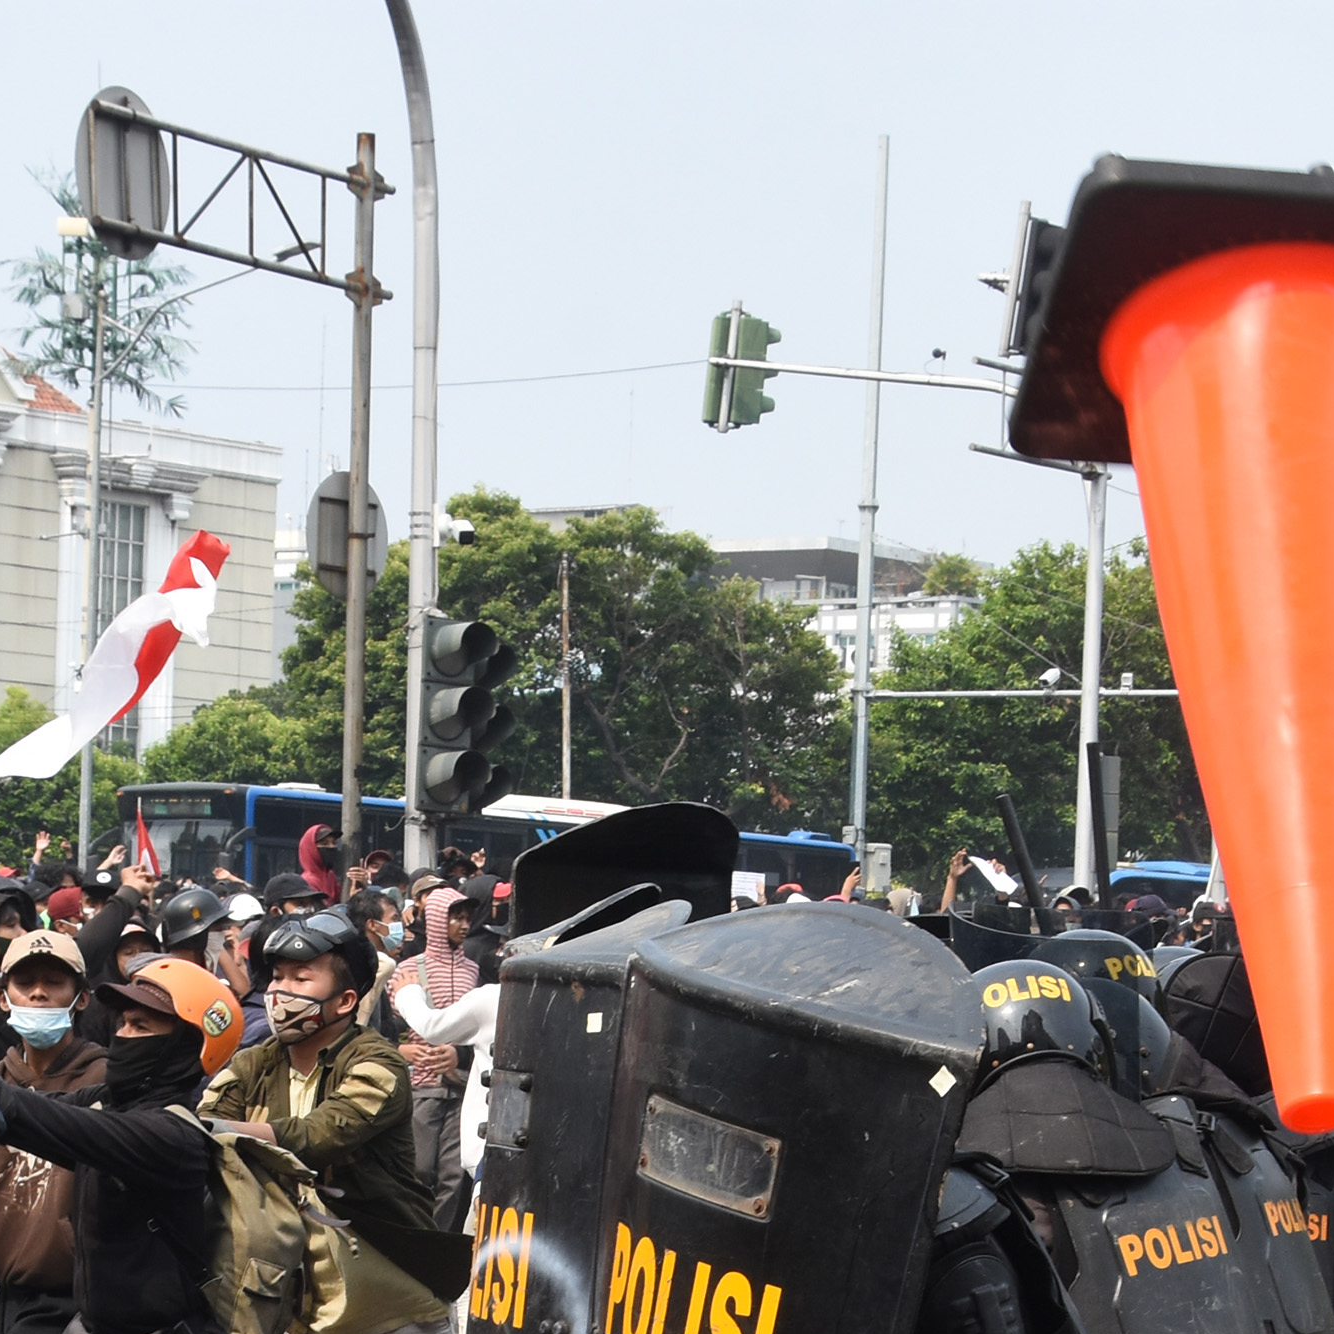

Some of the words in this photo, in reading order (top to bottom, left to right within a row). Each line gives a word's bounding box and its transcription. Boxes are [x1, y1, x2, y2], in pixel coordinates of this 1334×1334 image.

[983, 975, 1071, 1008] OLISI
[470, 1203, 534, 1328] LISI
[1117, 1215, 1229, 1277] POLISI
